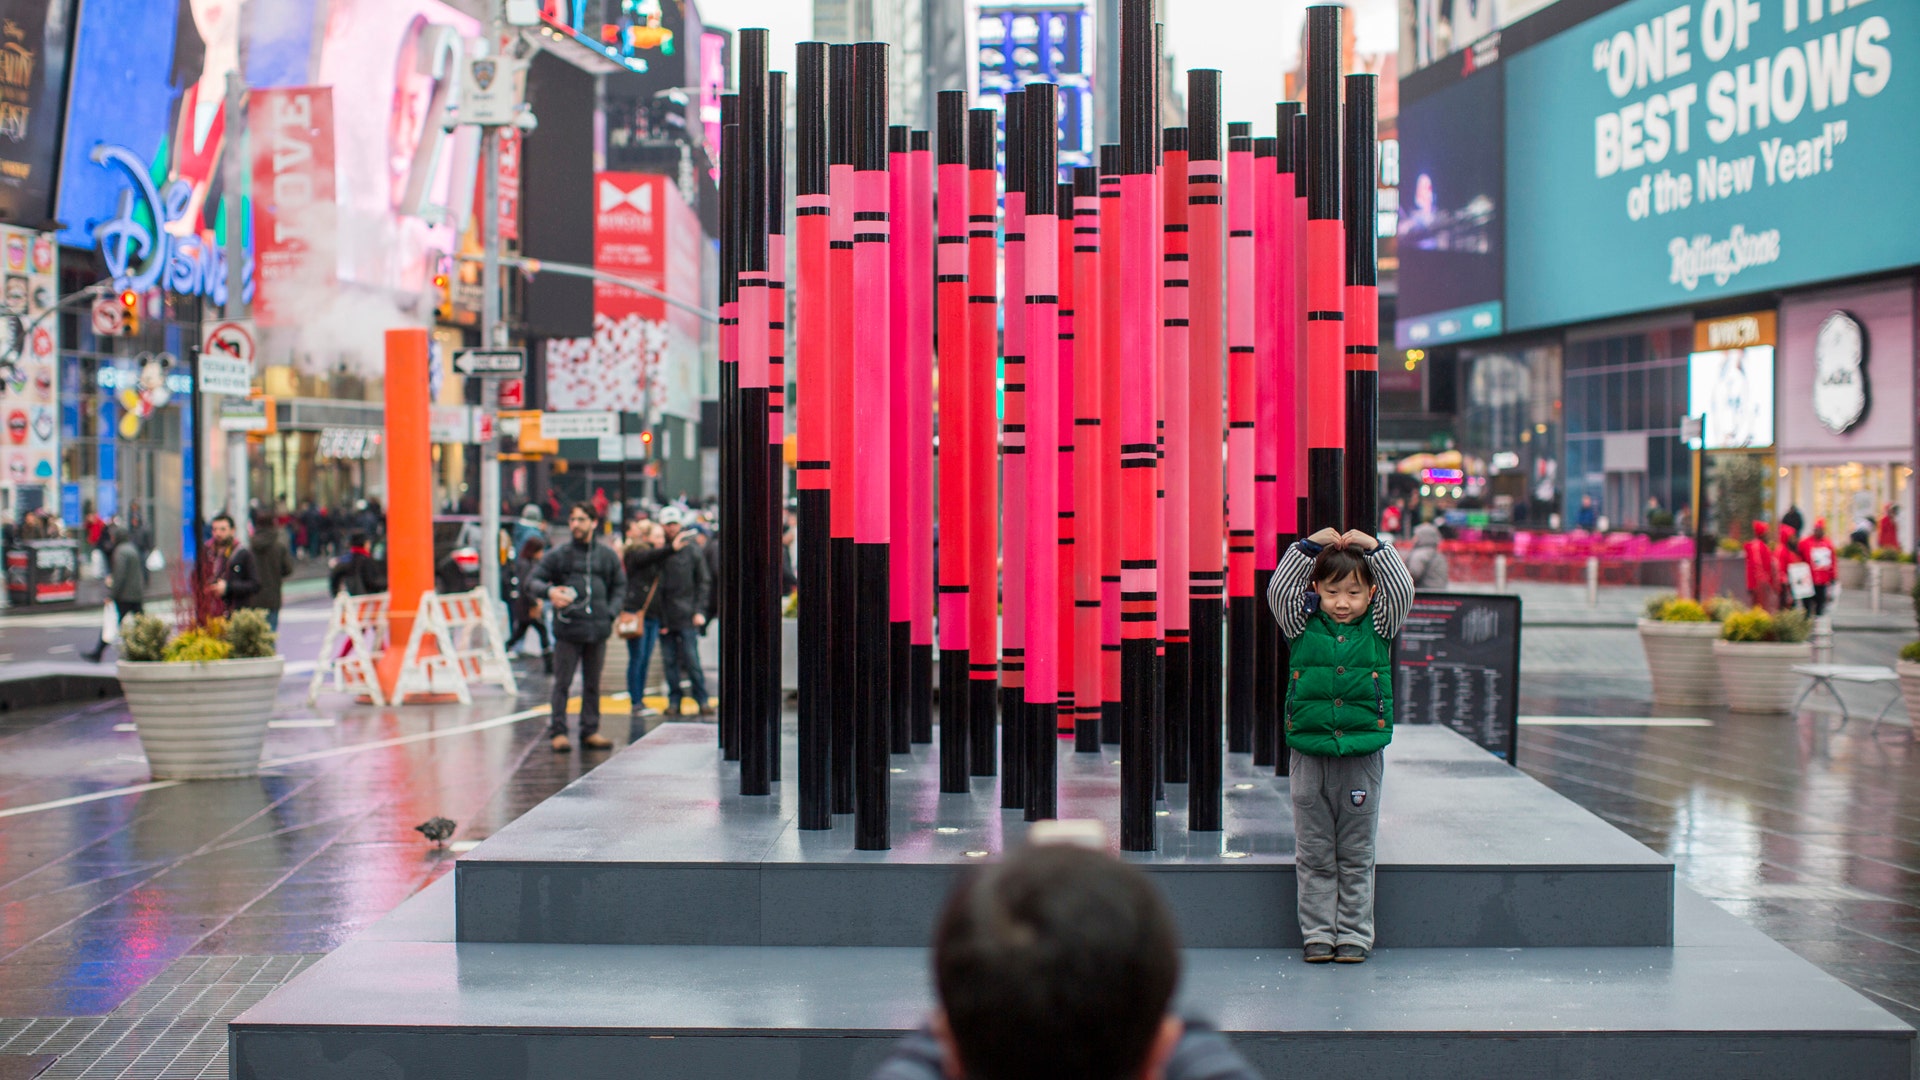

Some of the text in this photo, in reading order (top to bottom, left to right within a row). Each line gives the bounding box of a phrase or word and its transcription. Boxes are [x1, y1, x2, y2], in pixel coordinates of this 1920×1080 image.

[1594, 15, 1892, 179] BEST SHOWS
[1627, 174, 1652, 221] of
[1653, 168, 1693, 215] the
[1697, 155, 1755, 204] New
